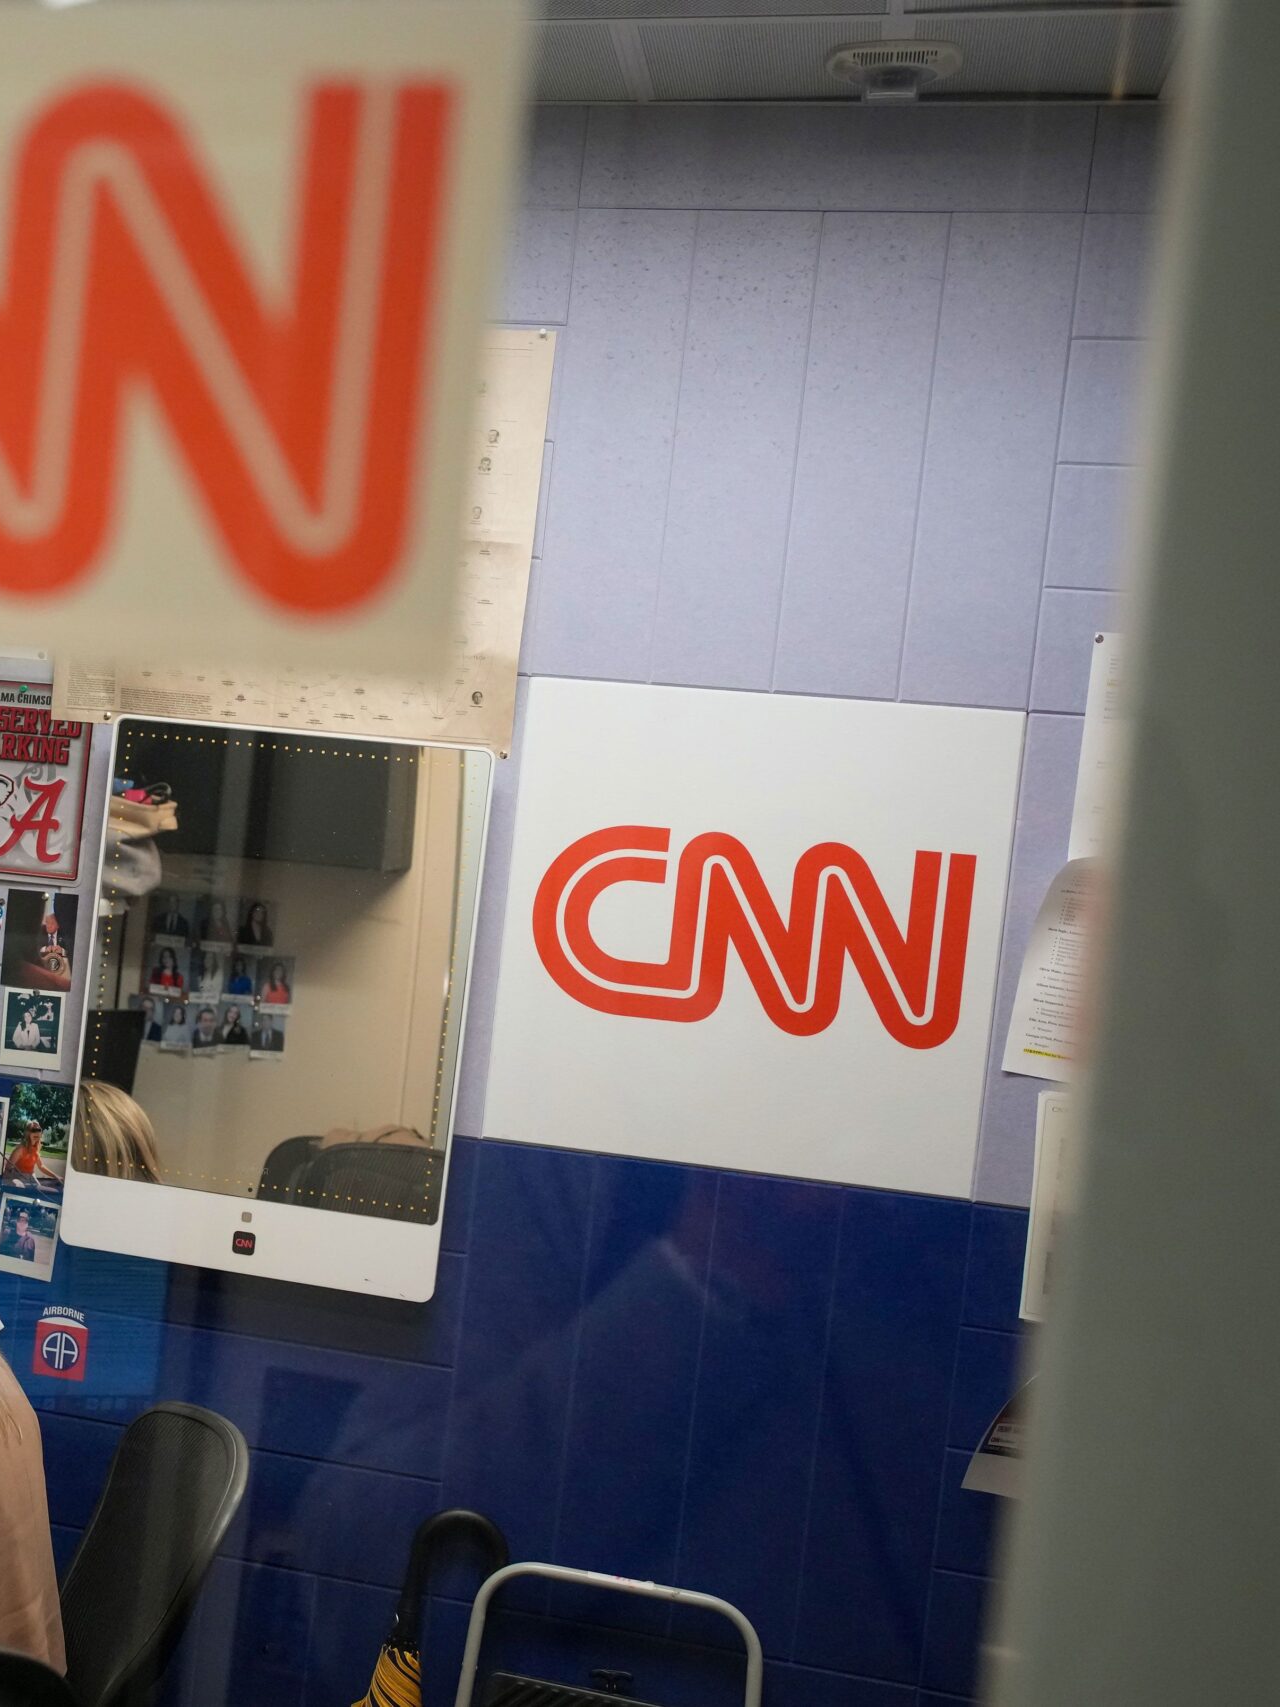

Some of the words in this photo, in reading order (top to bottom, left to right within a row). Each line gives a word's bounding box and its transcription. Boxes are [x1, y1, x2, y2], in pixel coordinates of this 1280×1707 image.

[17, 692, 52, 706] CRIMSO
[532, 824, 977, 1050] CNN
[235, 1238, 253, 1248] CNN
[42, 1306, 85, 1323] AIRBORNE
